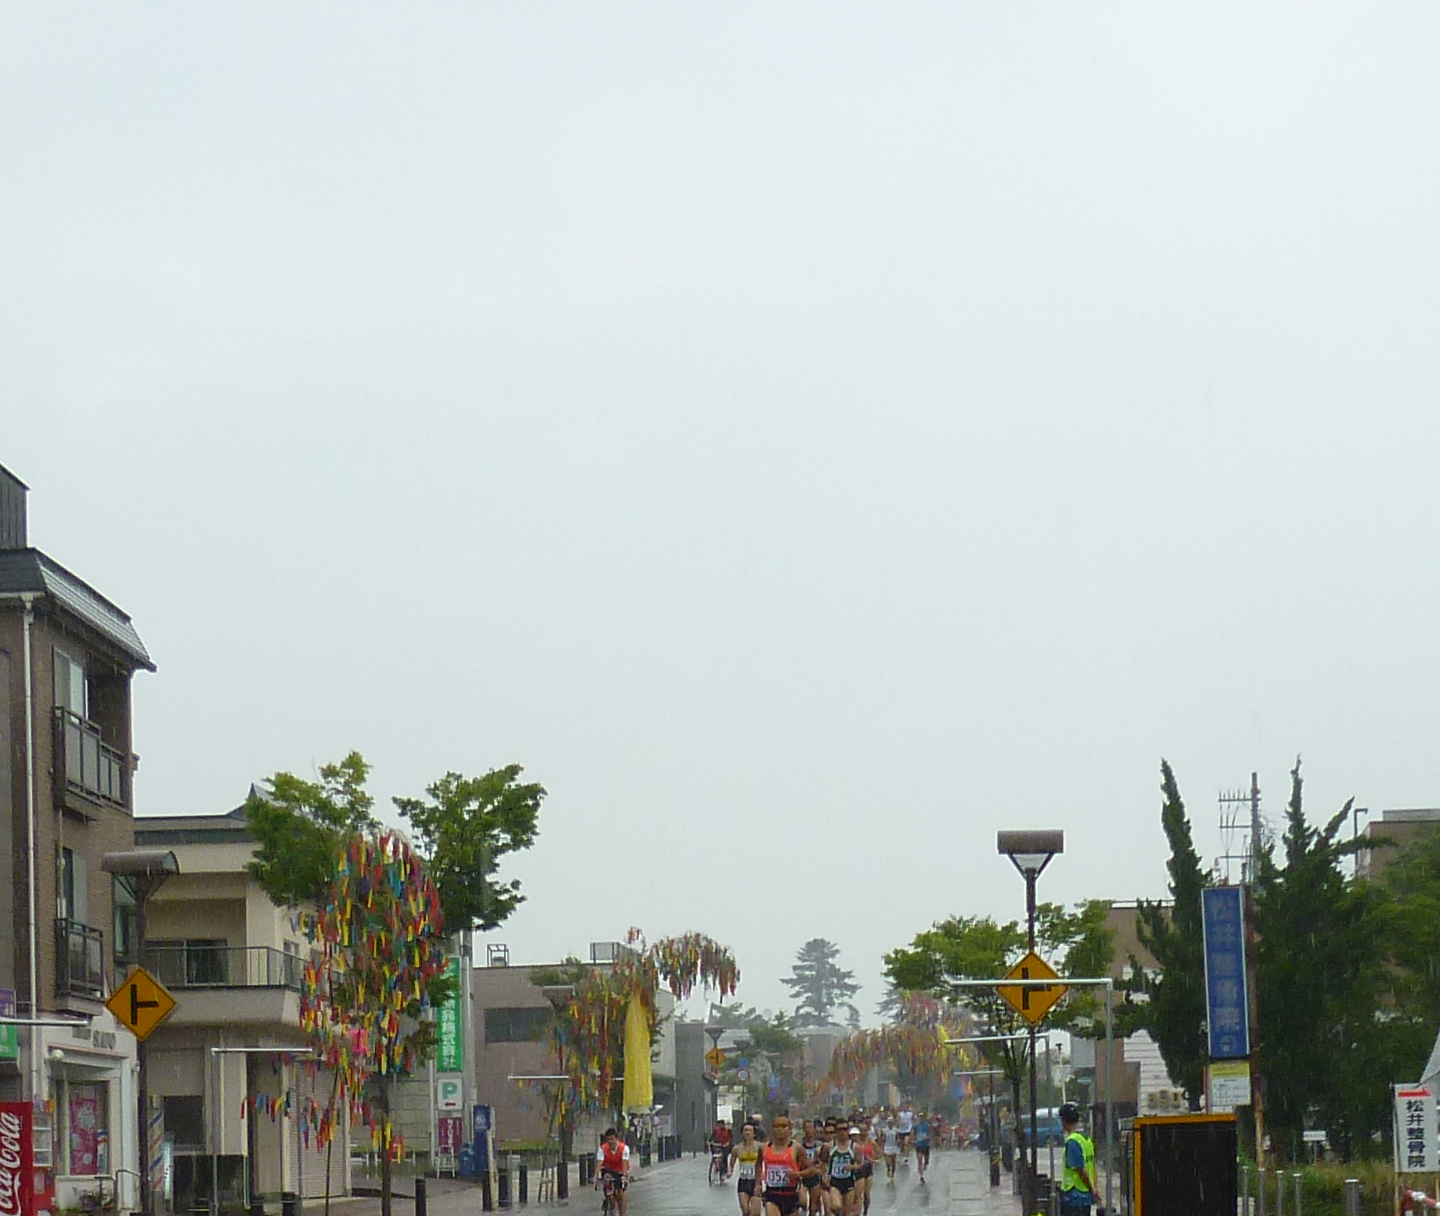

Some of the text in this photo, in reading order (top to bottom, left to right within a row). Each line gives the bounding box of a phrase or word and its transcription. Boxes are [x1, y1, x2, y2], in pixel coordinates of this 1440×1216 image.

[441, 1082, 458, 1100] P
[1406, 1099, 1426, 1169] 松井整骨院
